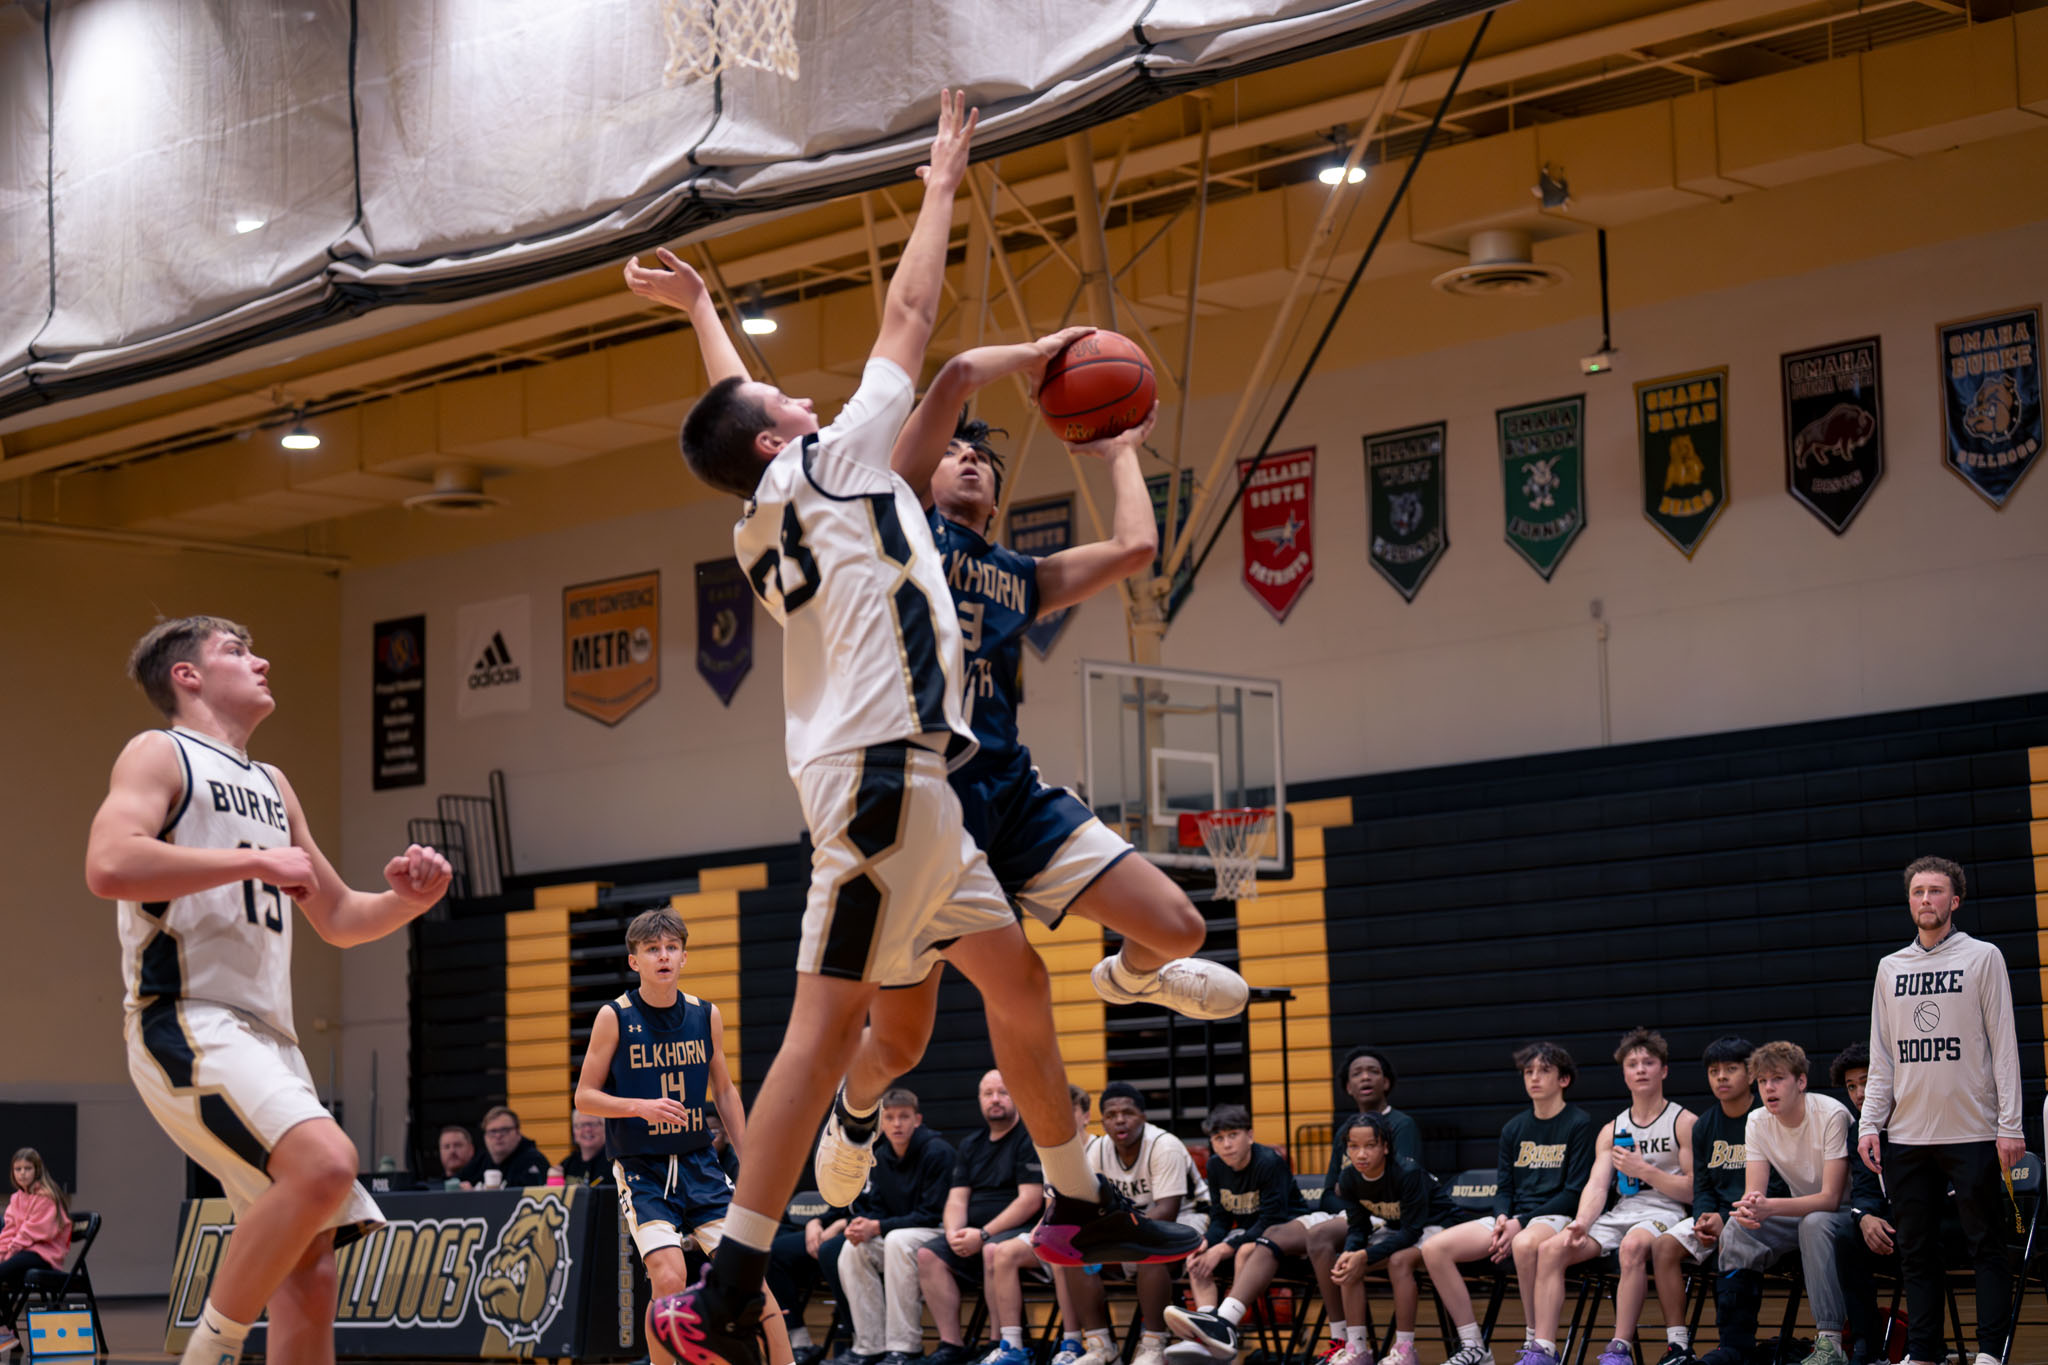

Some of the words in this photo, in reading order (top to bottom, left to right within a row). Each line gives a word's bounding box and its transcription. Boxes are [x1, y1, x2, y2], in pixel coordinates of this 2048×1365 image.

[1949, 322, 2030, 356] OMAHA
[1790, 349, 1872, 382] OMAHA
[1951, 344, 2032, 379] BURKE
[1645, 380, 1718, 411] OMAHA
[1508, 408, 1576, 434] OMAHA
[1648, 401, 1717, 433] BRYAN
[1244, 460, 1311, 487] ILLARD
[1250, 482, 1306, 508] SOUTH
[941, 549, 1026, 615] KHORN
[468, 665, 521, 690] adidas
[206, 779, 287, 832] BURKE
[1894, 970, 1964, 997] BURKE
[629, 1039, 707, 1069] ELKHORN
[1898, 1037, 1961, 1063] HOOPS
[660, 1071, 686, 1103] 14
[1638, 1138, 1671, 1154] RKE
[1451, 1185, 1498, 1197] BULLDO
[337, 1224, 484, 1320] LLDOGS
[619, 1200, 635, 1348] ULLDOGS
